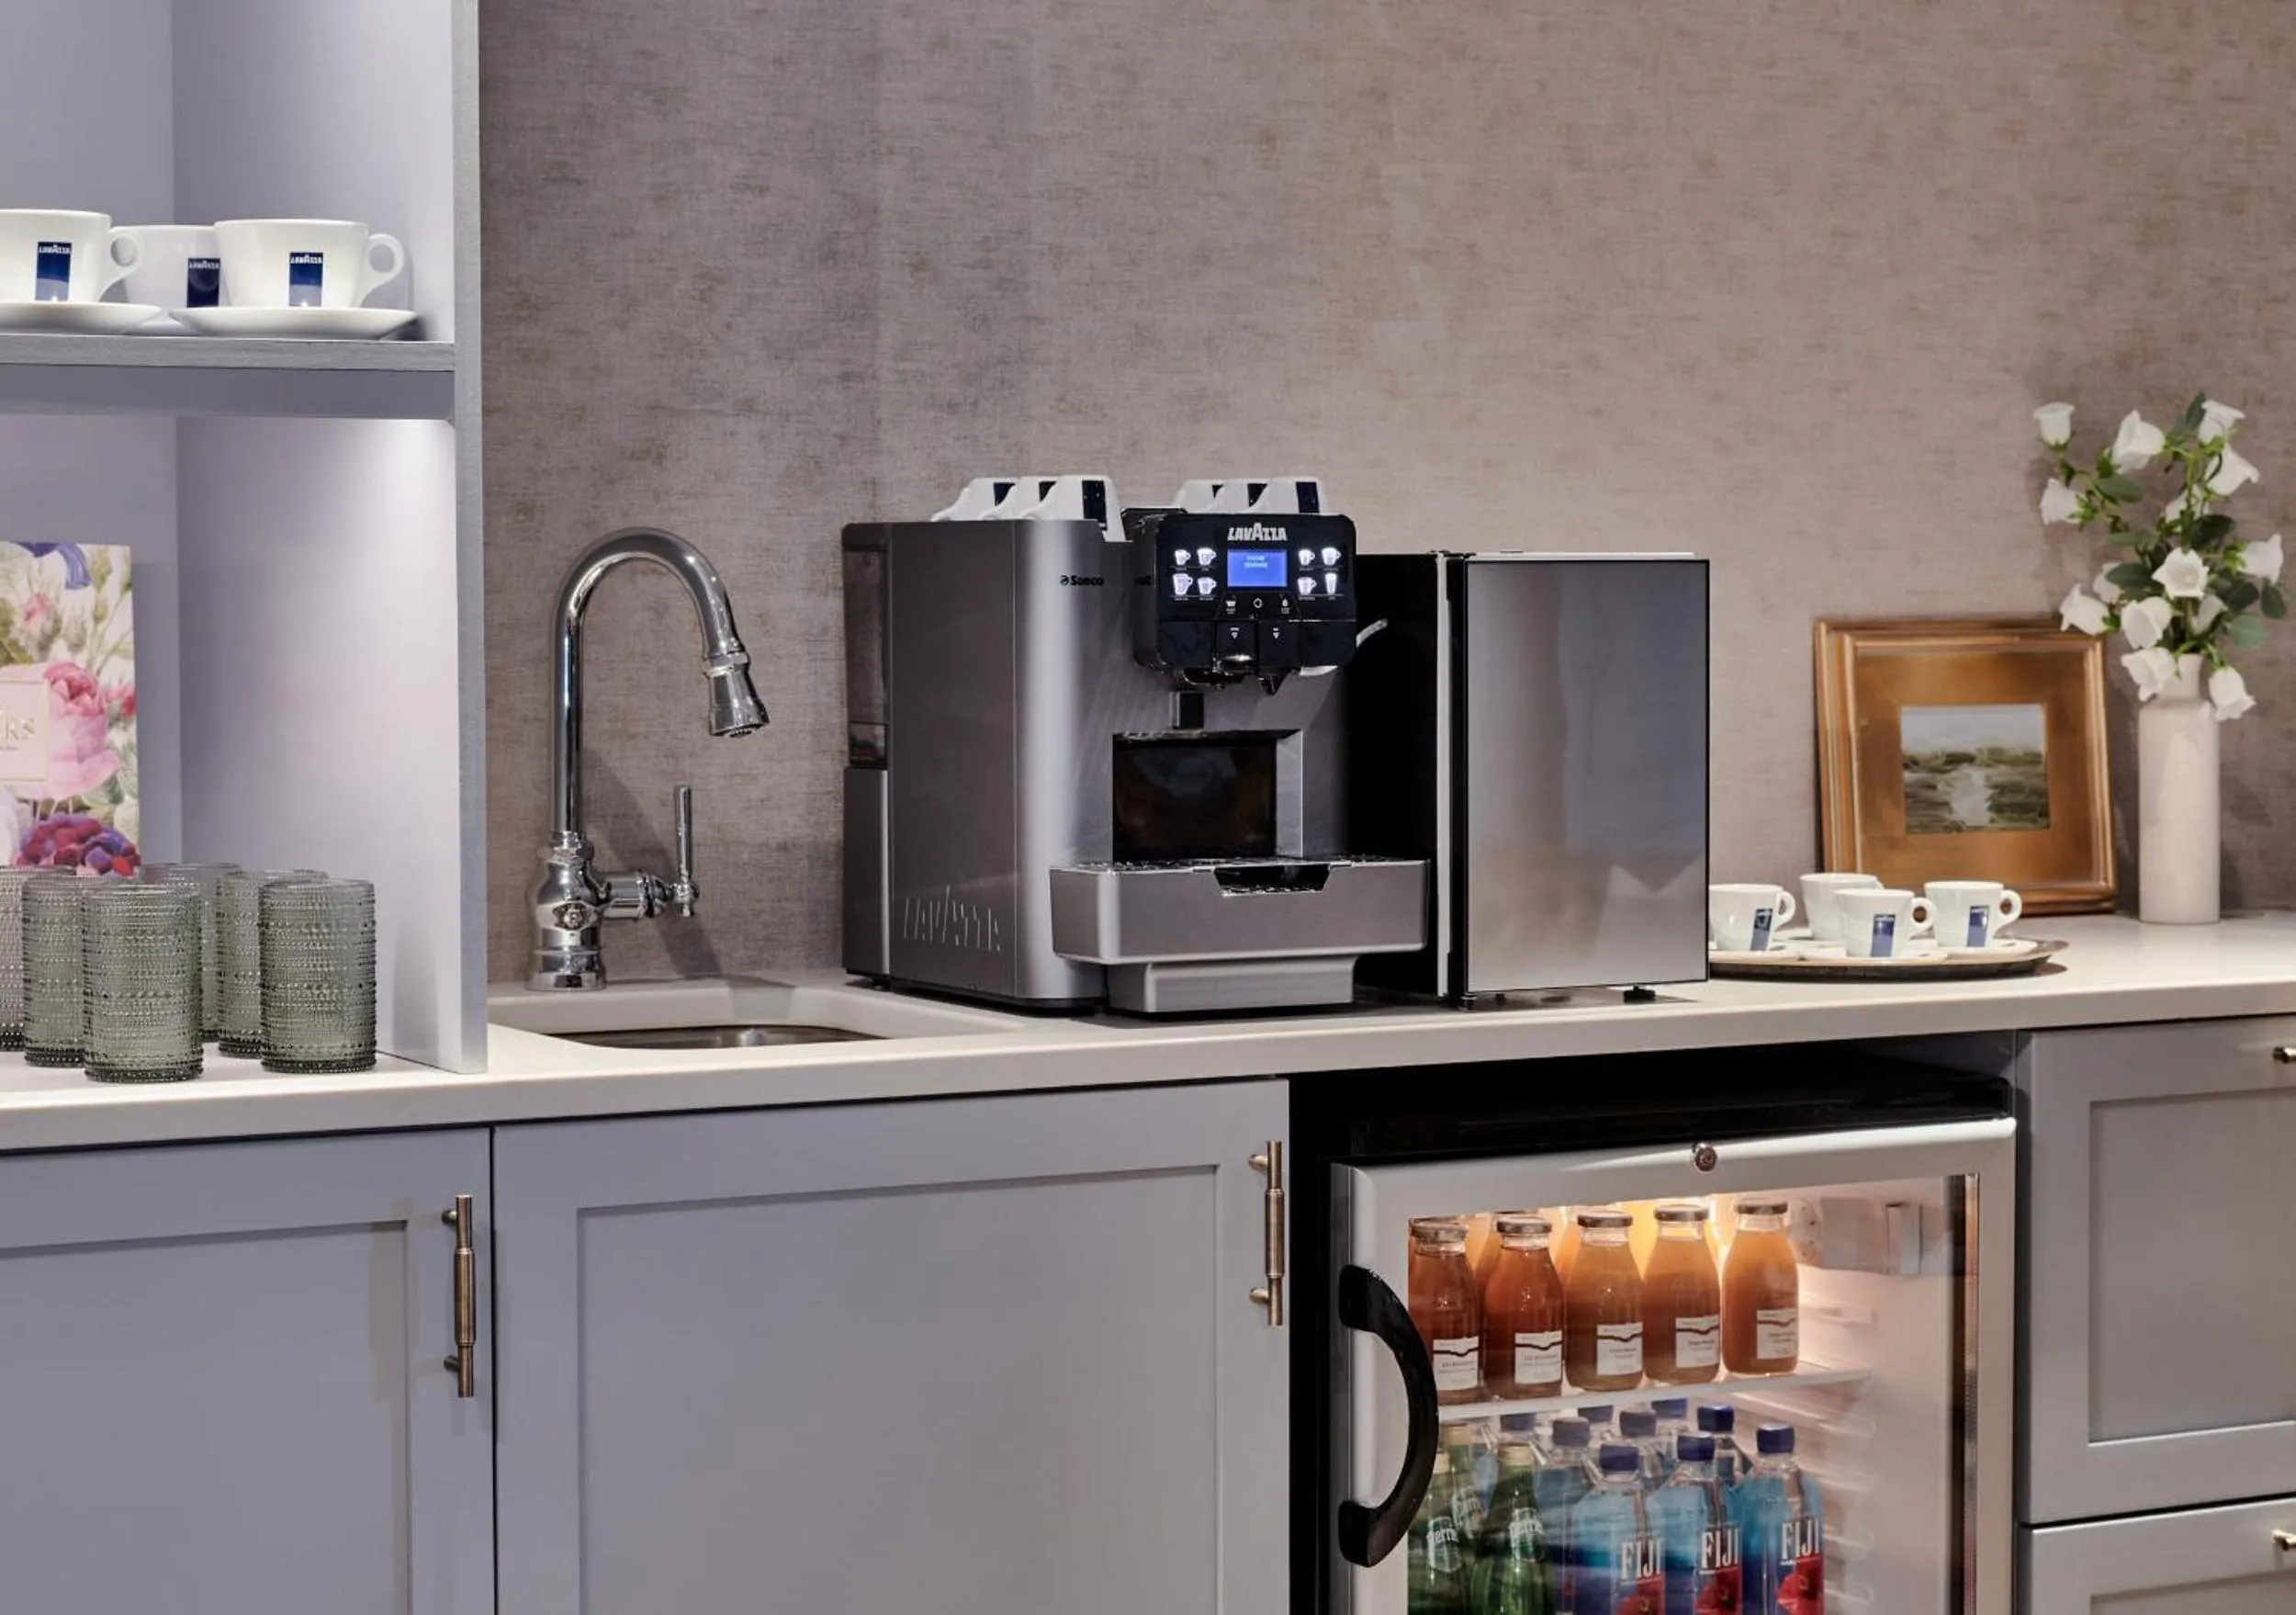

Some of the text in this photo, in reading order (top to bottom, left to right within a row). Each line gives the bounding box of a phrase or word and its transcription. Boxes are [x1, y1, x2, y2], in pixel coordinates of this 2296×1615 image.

[1227, 522, 1288, 541] LAVAZZA
[1070, 575, 1105, 586] Saeco
[1620, 1537, 1663, 1580] FIJI
[1701, 1528, 1739, 1569] FIJI
[1782, 1519, 1820, 1560] FIJI
